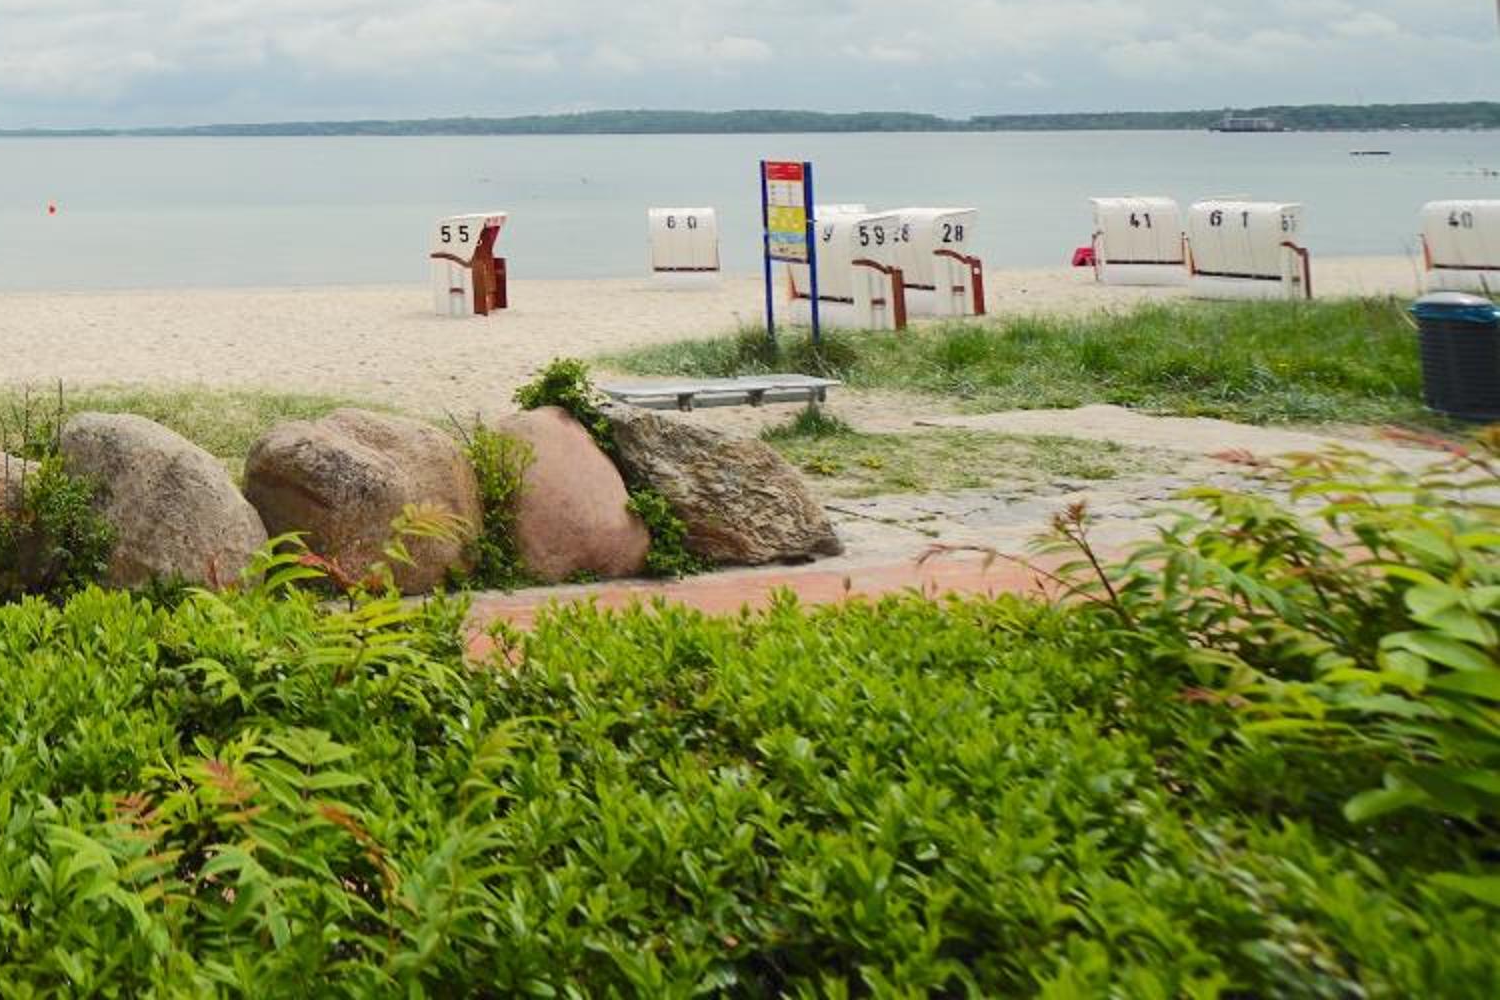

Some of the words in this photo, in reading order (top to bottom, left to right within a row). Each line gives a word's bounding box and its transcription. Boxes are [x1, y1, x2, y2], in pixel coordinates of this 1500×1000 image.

[666, 215, 697, 230] 60
[1129, 212, 1152, 229] 41
[1209, 209, 1248, 228] 61
[440, 225, 469, 244] 55
[859, 226, 885, 247] 59
[942, 222, 964, 243] 28
